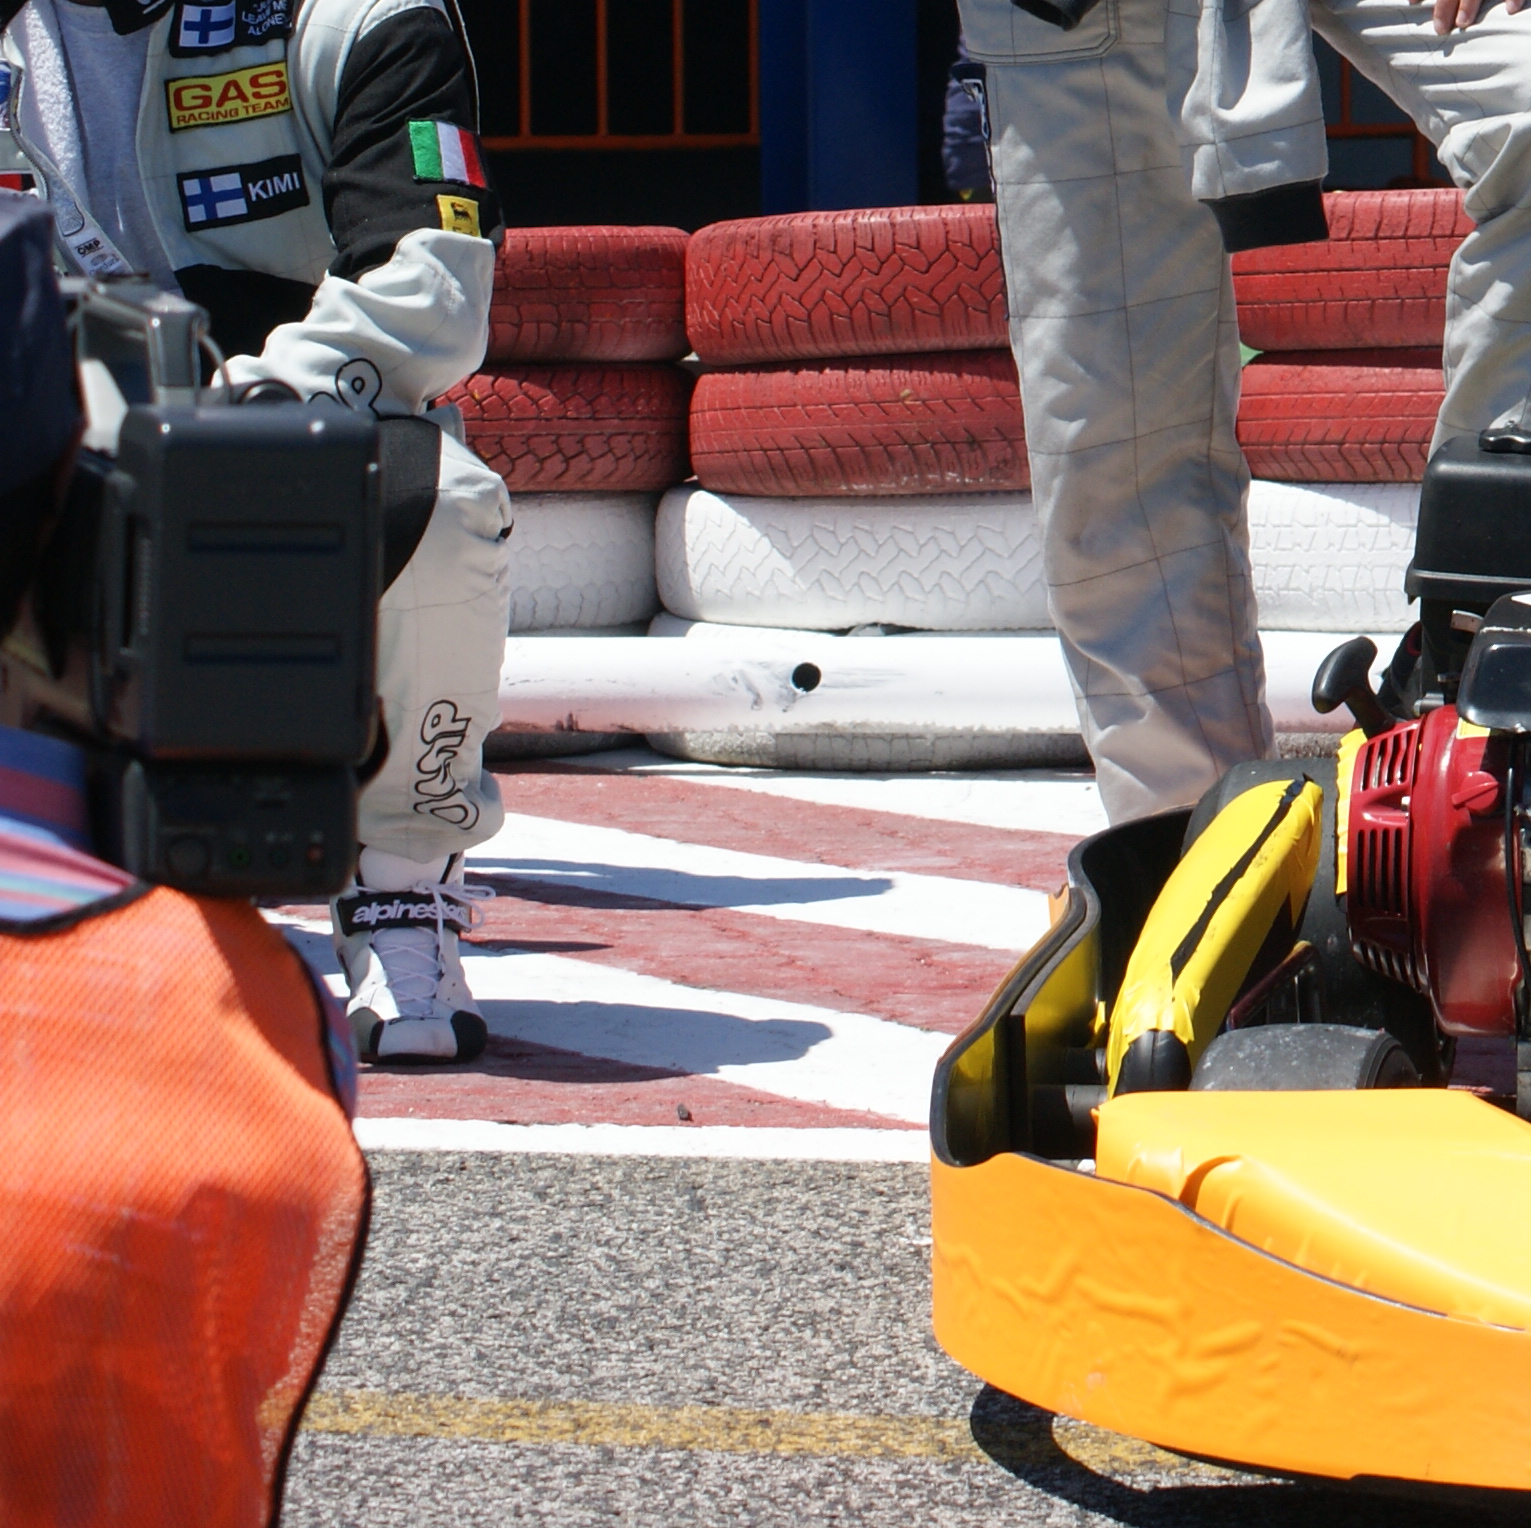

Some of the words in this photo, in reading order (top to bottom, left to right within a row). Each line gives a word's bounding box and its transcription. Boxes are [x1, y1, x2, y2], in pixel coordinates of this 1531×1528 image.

[173, 70, 287, 112] GAS
[176, 107, 239, 126] RACING
[242, 97, 290, 115] TEAM
[248, 172, 300, 202] KIMI
[77, 239, 101, 255] OMP
